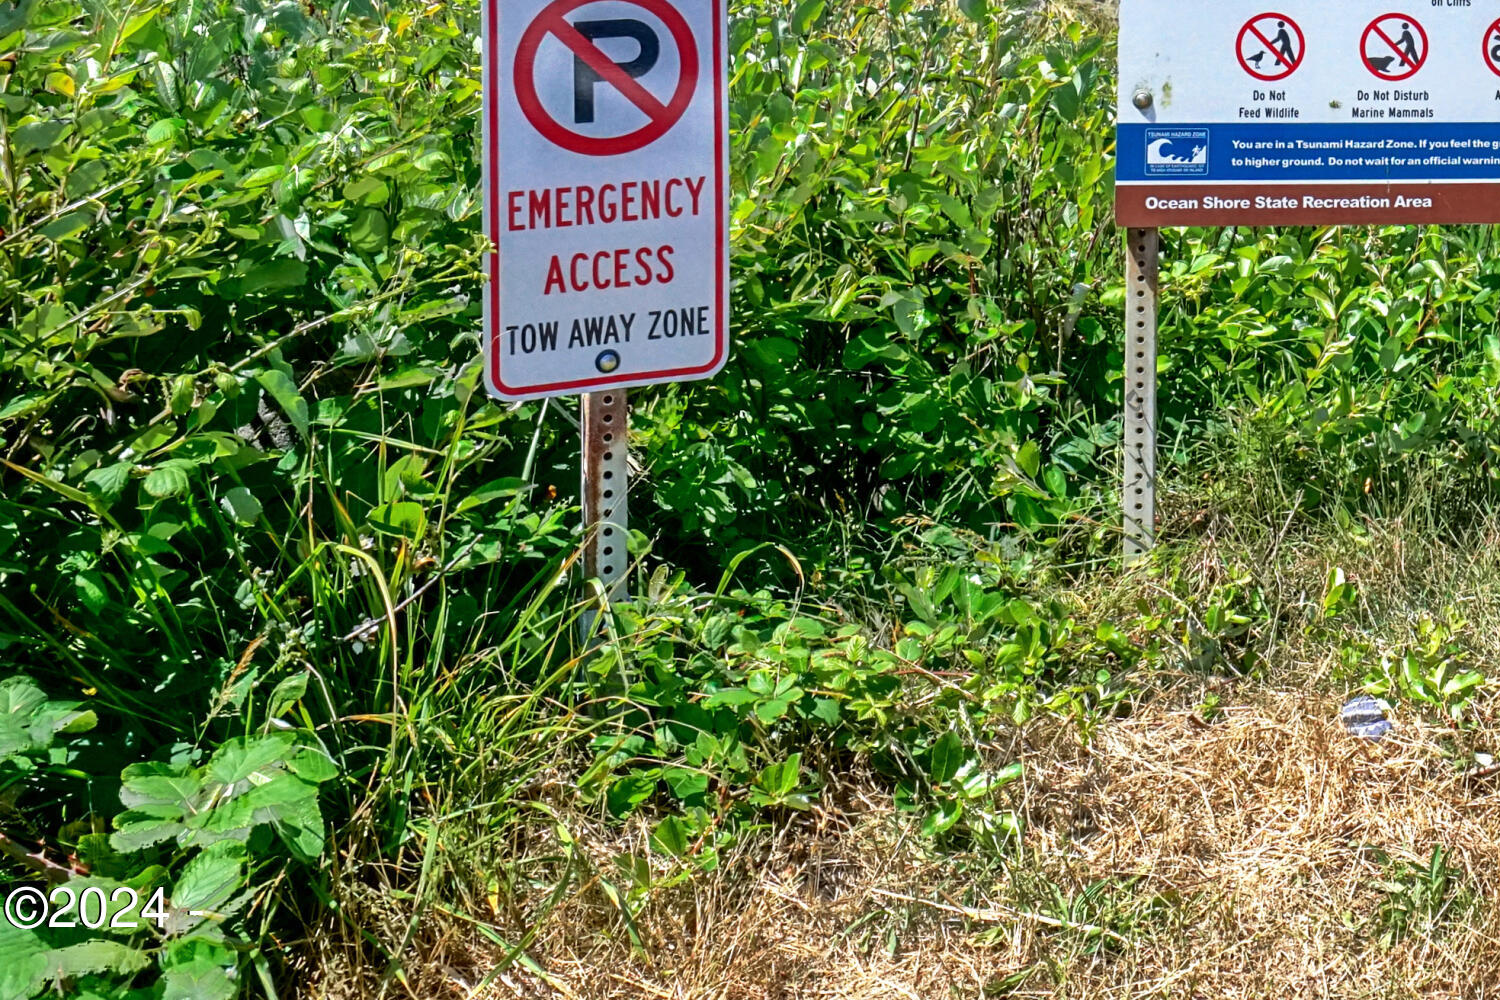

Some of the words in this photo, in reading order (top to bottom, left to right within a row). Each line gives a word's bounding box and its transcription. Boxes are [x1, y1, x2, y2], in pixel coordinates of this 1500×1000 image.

[1253, 90, 1265, 102] Do
[1269, 90, 1286, 102] Not
[1357, 90, 1369, 102] Do
[1374, 90, 1391, 102] Not
[1395, 90, 1430, 102] Disturb
[1238, 107, 1261, 118] Feed
[1265, 107, 1300, 118] Wildlife
[1352, 107, 1384, 119] Marine
[1388, 108, 1434, 119] Mammals
[1232, 140, 1253, 149] You
[1275, 140, 1285, 149] in
[1296, 140, 1344, 149] Tsunami
[1345, 140, 1384, 149] Hazard
[1386, 140, 1416, 149] Zone.
[1418, 140, 1428, 149] If
[1429, 142, 1447, 152] you
[1450, 139, 1471, 149] feel
[1472, 139, 1490, 149] the
[1232, 158, 1243, 166] to
[1245, 157, 1280, 168] higher
[1282, 157, 1324, 168] ground.
[1328, 158, 1346, 166] Do
[1348, 158, 1362, 166] not
[1365, 157, 1388, 166] wait
[1390, 157, 1407, 166] for
[1423, 156, 1460, 166] official
[508, 176, 706, 232] EMERGENCY
[1145, 196, 1198, 210] Ocean
[1202, 196, 1250, 210] Shore
[1255, 195, 1298, 210] State
[1302, 195, 1390, 210] Recreation
[1394, 195, 1432, 209] Area
[544, 245, 674, 295] ACCESS
[506, 320, 559, 356] TOW
[568, 312, 636, 349] AWAY
[648, 306, 710, 340] ZONE
